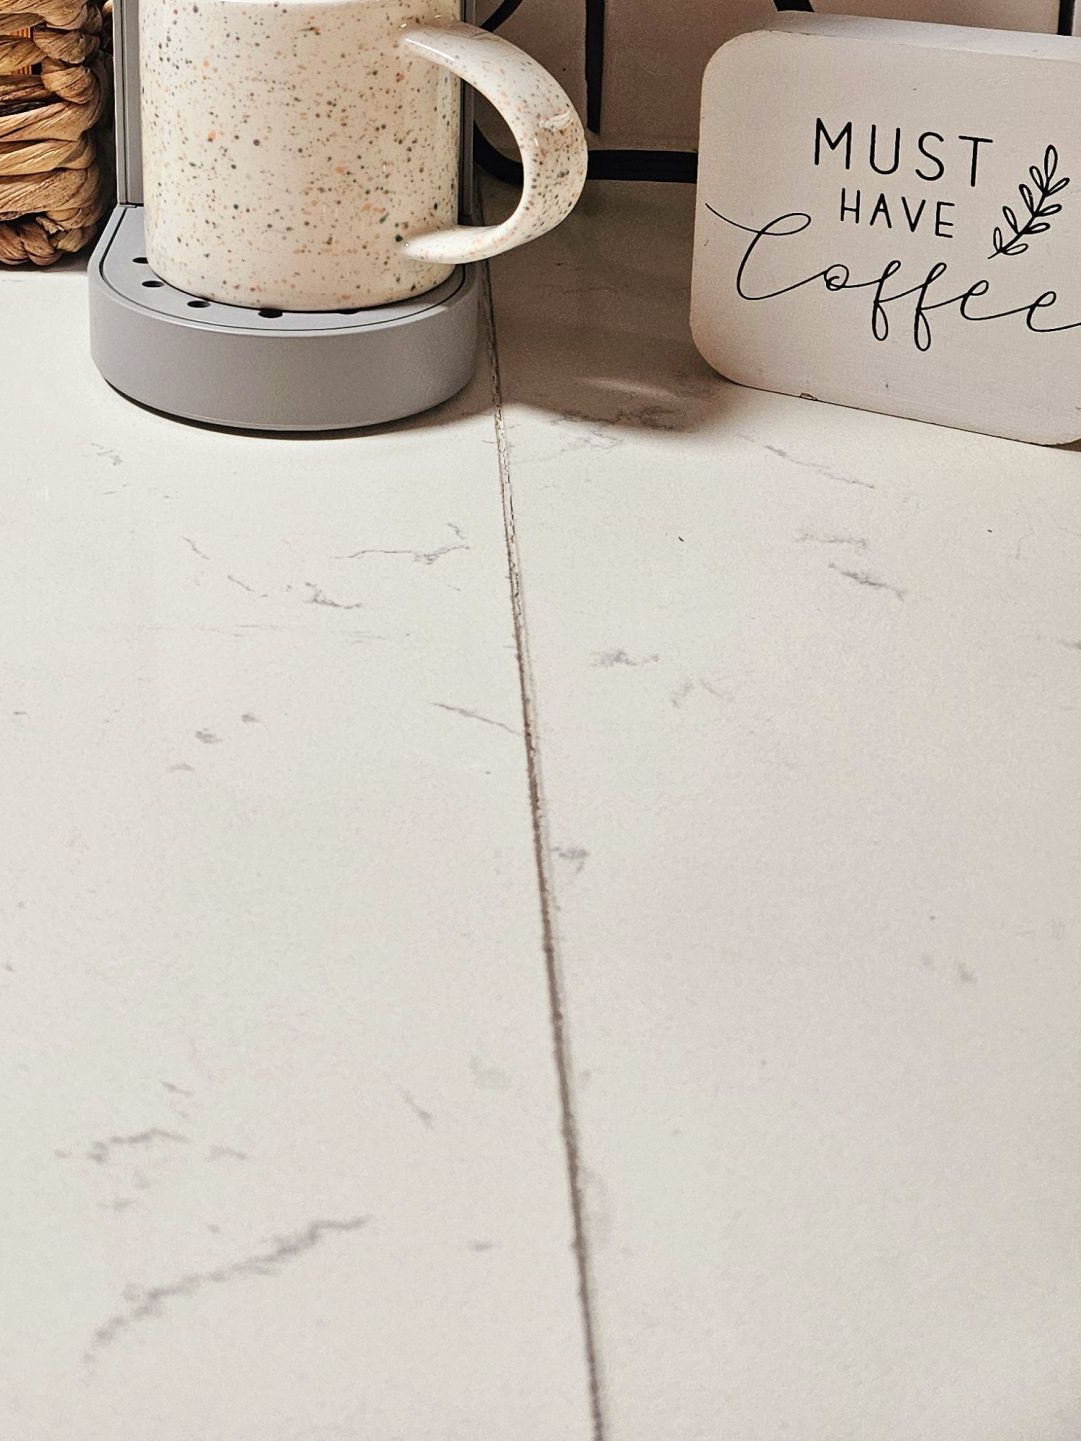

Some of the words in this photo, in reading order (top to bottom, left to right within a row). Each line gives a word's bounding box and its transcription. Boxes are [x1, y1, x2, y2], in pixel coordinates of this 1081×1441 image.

[813, 116, 994, 188] MUST
[839, 186, 956, 239] HAVE
[704, 202, 1081, 352] Coffee
